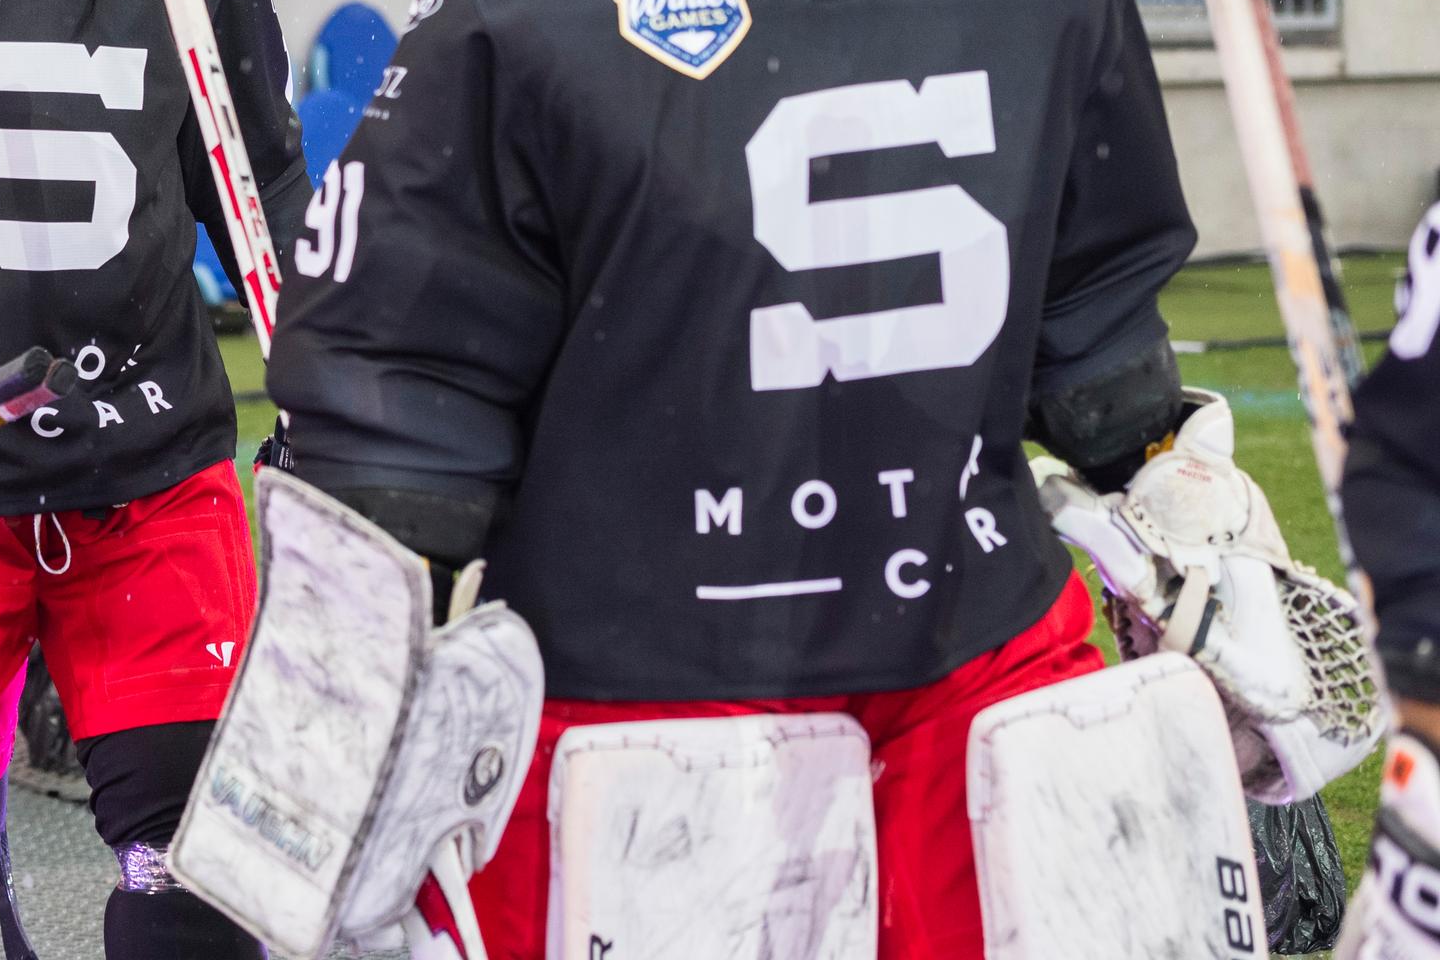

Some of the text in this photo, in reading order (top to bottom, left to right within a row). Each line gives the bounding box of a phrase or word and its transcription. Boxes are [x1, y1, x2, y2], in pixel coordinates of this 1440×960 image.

[648, 8, 728, 31] GAMES
[294, 159, 365, 283] 91
[745, 70, 1010, 392] S
[30, 380, 173, 438] CAR
[884, 507, 1008, 599] CR
[1216, 856, 1254, 960] Ba
